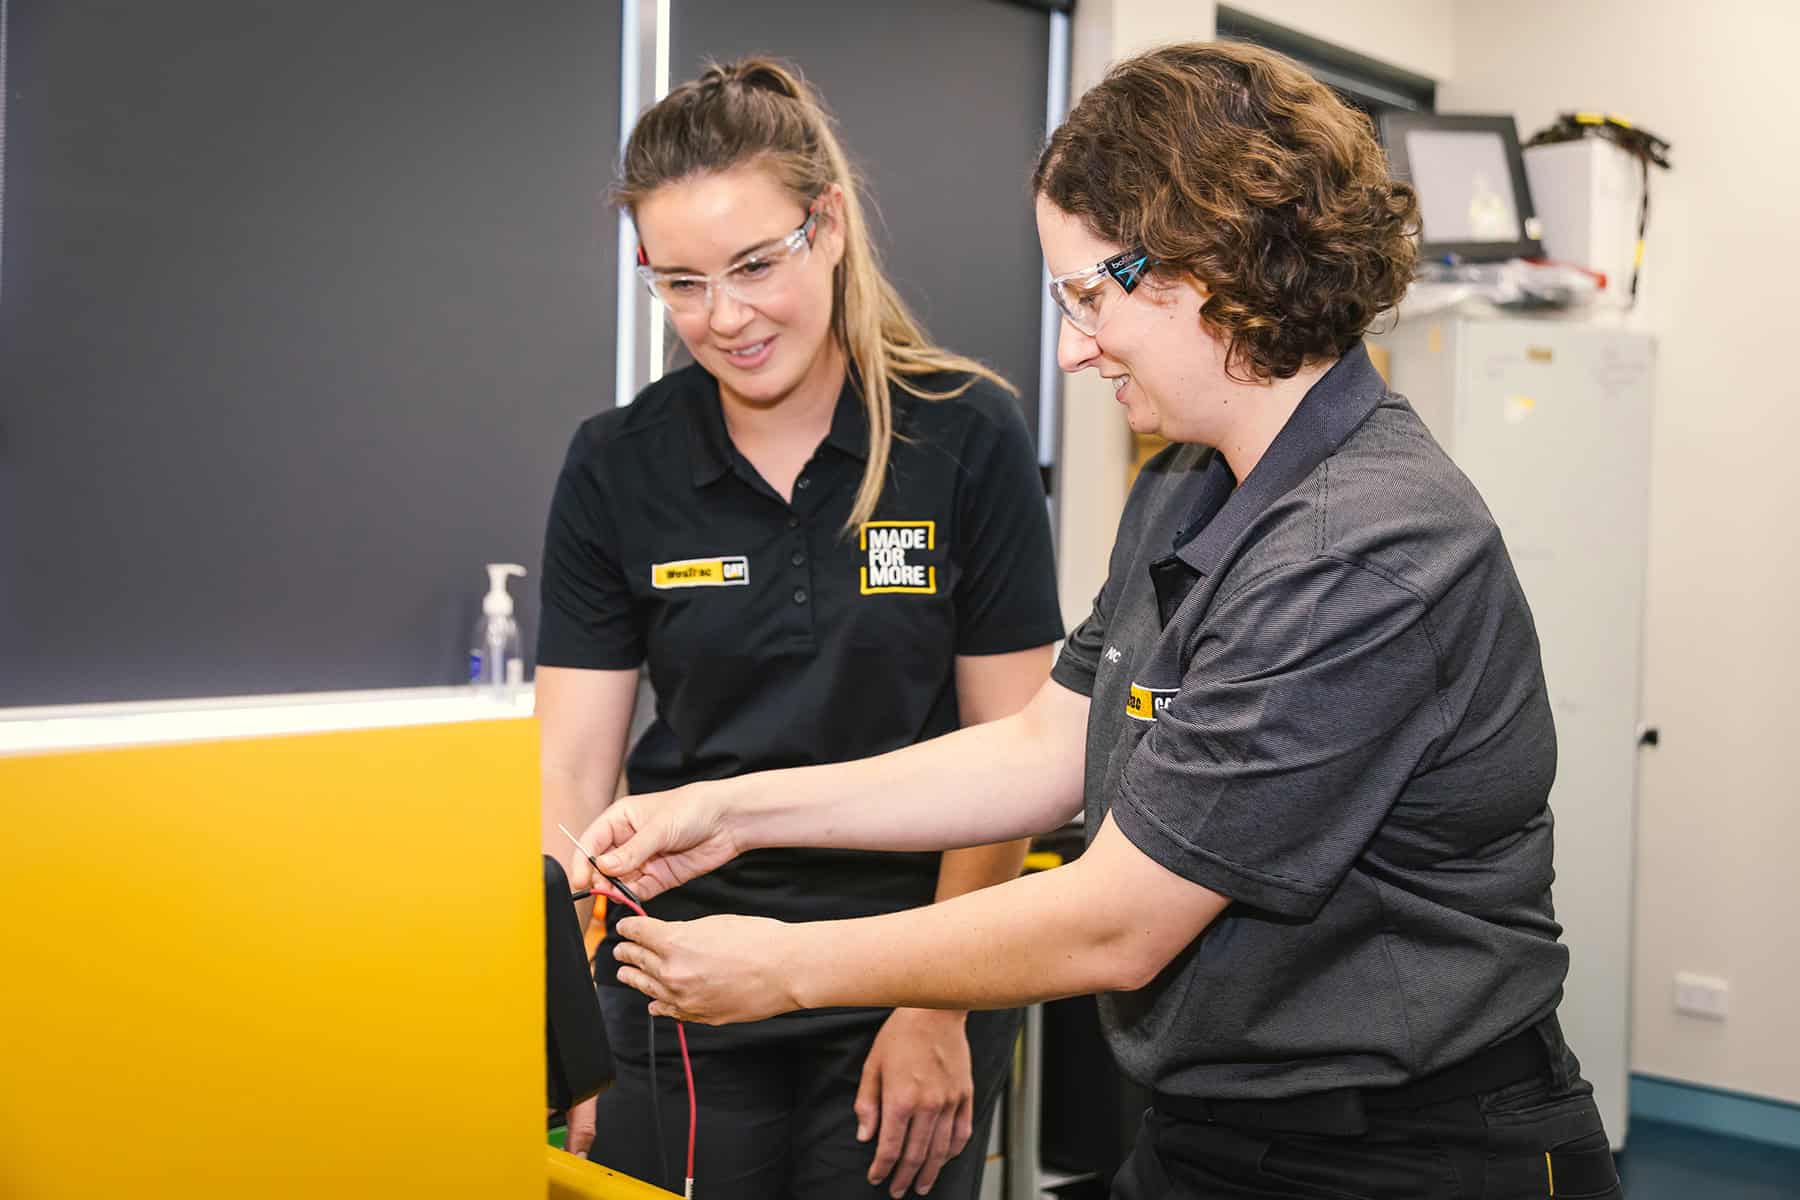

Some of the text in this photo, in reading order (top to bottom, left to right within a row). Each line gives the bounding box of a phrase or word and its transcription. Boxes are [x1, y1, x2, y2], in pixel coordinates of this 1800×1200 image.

[869, 528, 926, 549] MADE
[869, 548, 905, 567] FOR
[723, 563, 744, 578] CAT
[869, 566, 926, 586] MORE
[1105, 646, 1121, 663] NC
